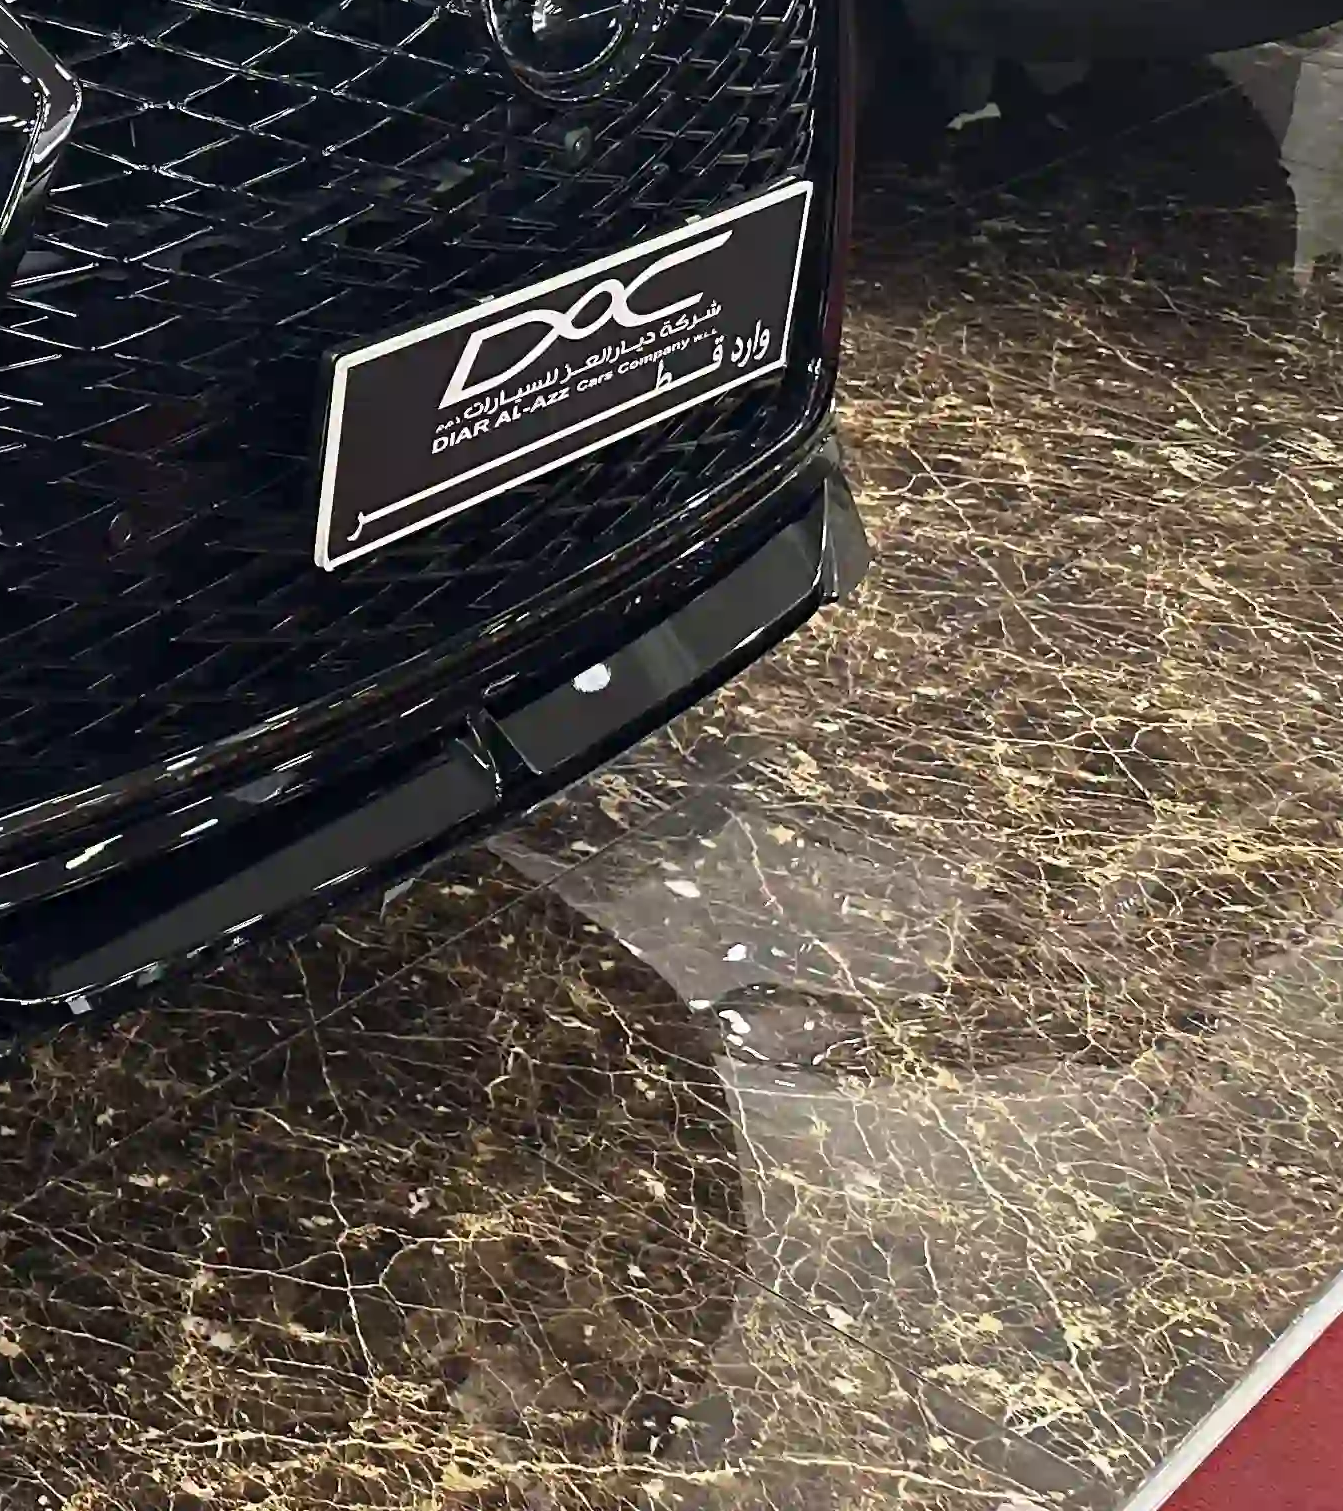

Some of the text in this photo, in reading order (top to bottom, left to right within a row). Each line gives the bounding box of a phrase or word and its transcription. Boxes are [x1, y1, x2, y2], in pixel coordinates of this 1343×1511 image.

[659, 299, 723, 338] شركة
[730, 319, 772, 368] وارد
[431, 416, 491, 455] DIAR
[576, 370, 614, 392] Cars
[617, 337, 691, 374] Company
[463, 367, 559, 420] للسيارات
